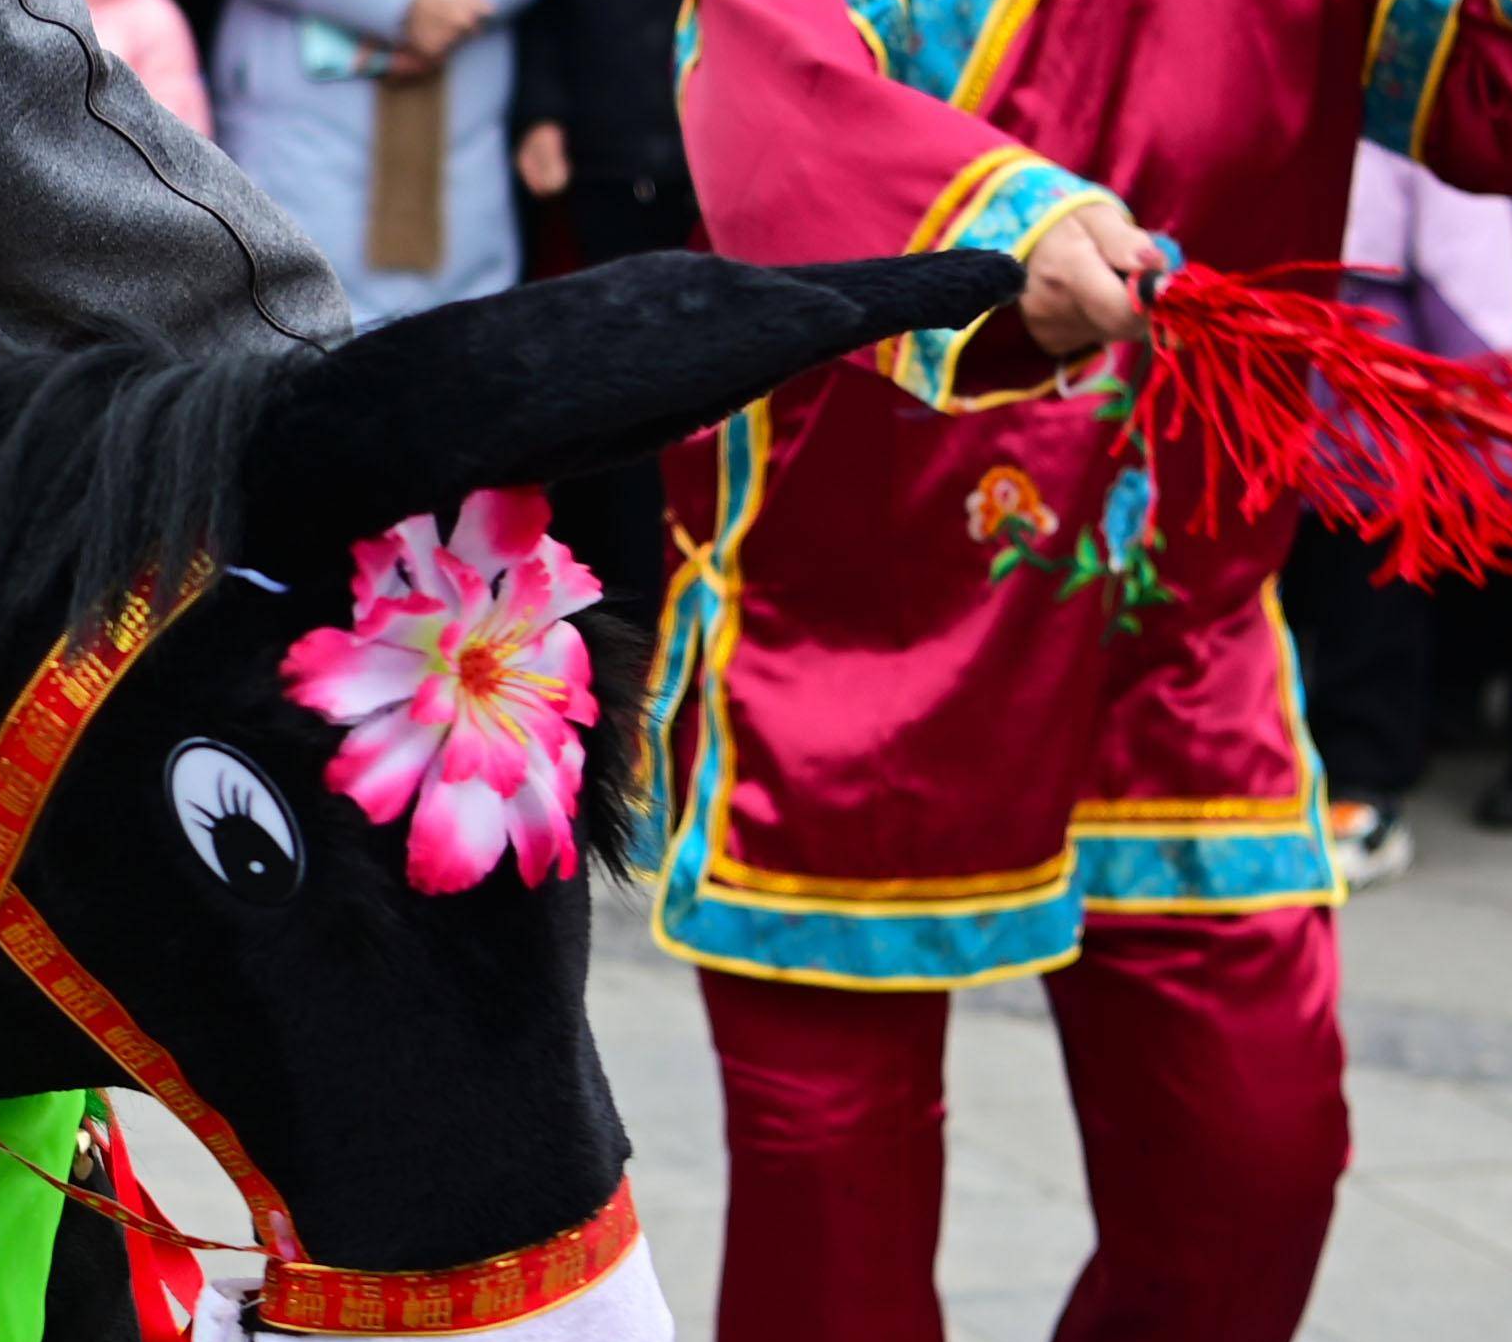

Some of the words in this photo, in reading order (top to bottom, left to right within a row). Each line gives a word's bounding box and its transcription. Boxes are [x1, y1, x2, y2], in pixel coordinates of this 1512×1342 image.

[339, 1275, 386, 1329] 福
[401, 1277, 453, 1328] 福
[470, 1259, 525, 1320] 福
